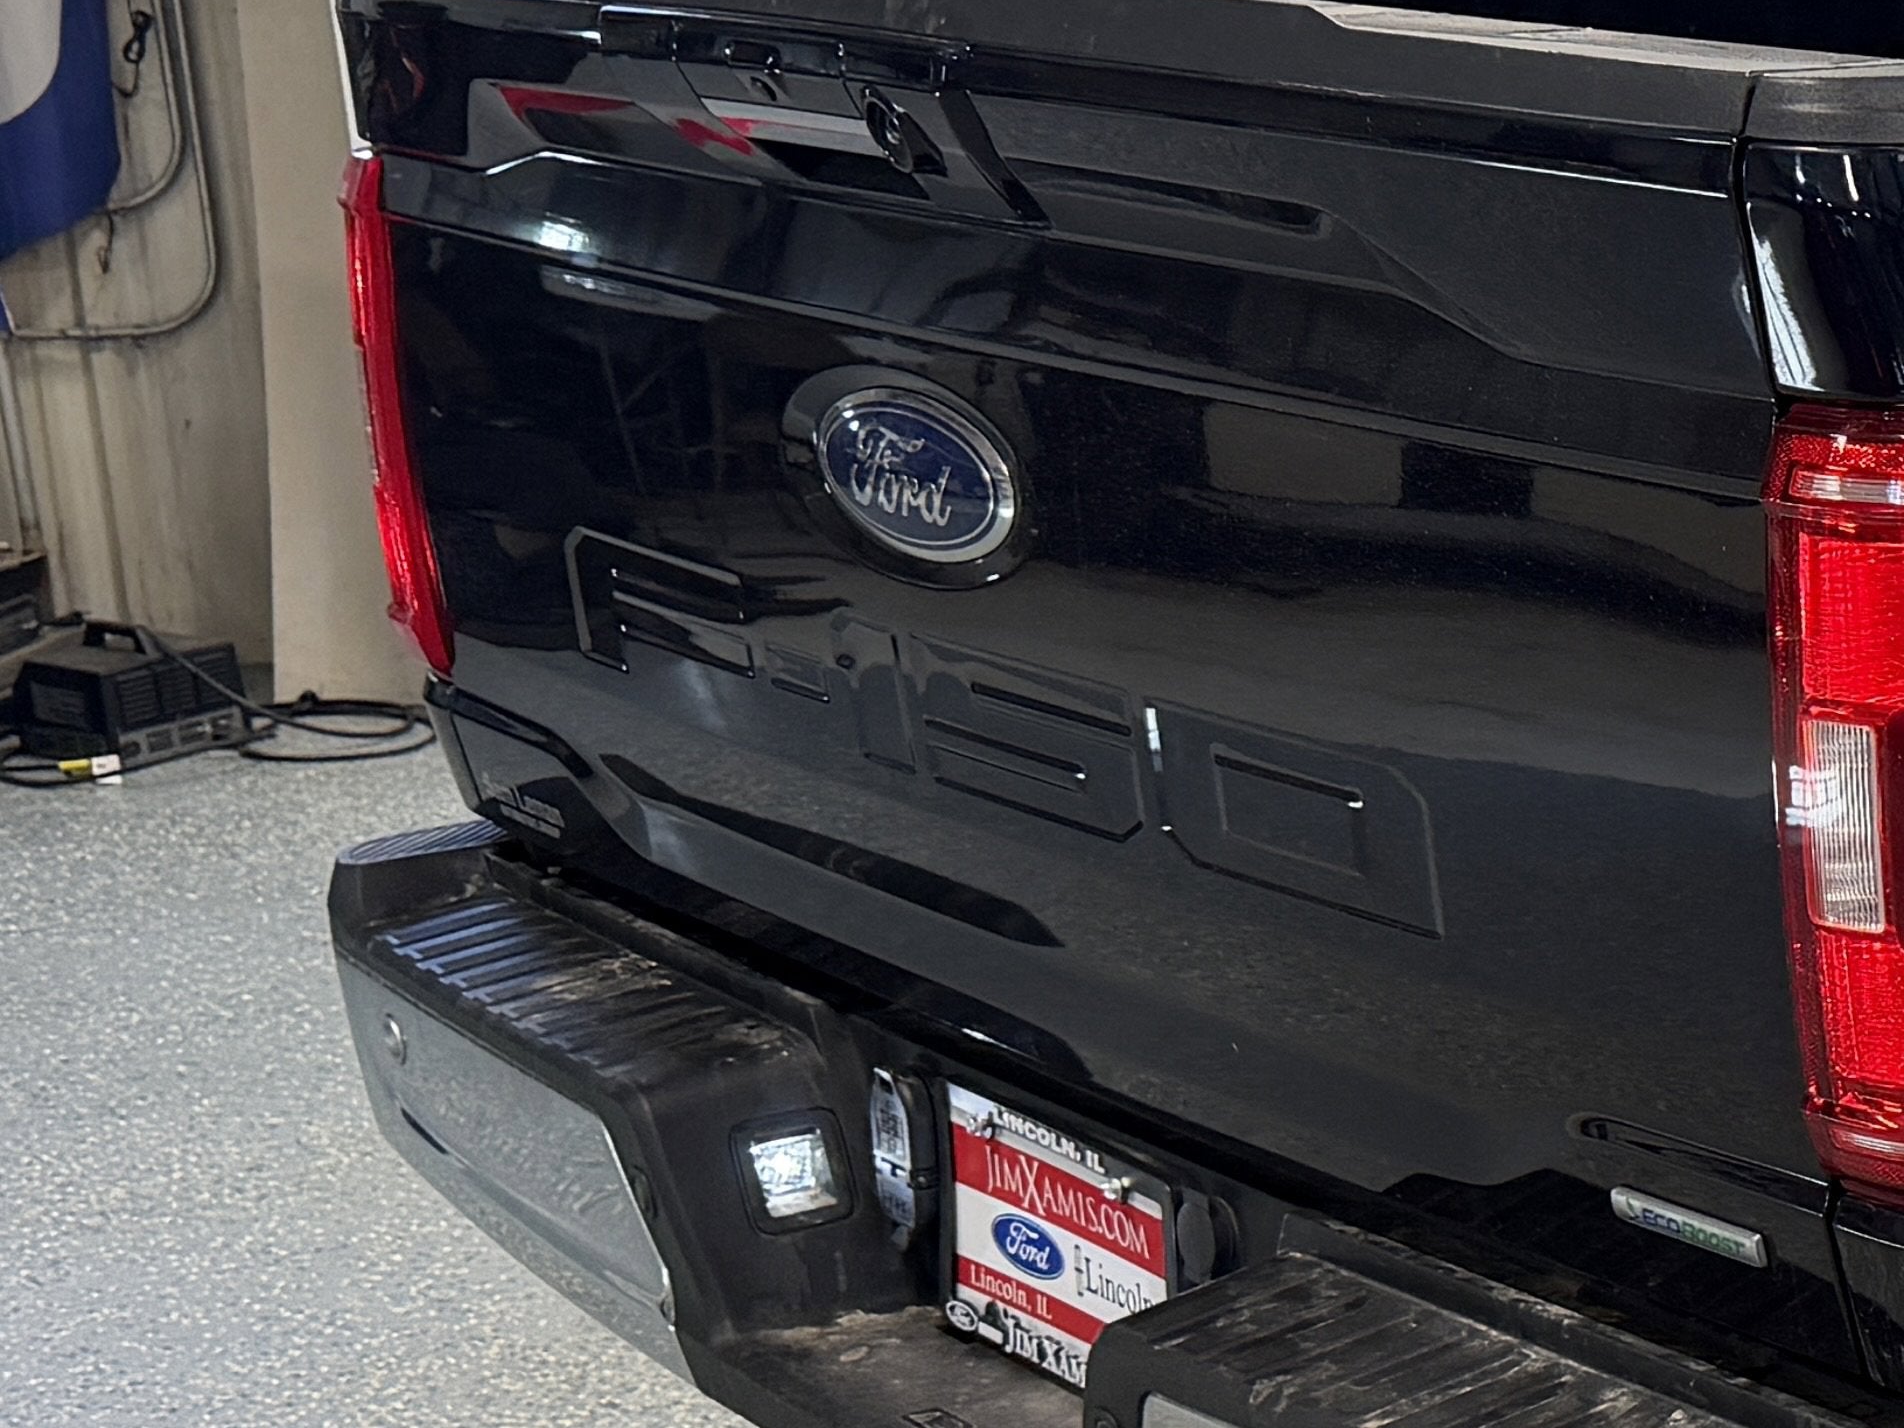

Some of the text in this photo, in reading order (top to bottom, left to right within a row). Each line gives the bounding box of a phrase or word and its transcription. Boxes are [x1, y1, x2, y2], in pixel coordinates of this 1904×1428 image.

[851, 425, 951, 526] Ford
[985, 1144, 1150, 1260] JIMXAMIS.COM
[1006, 1221, 1050, 1271] Ford
[969, 1264, 1053, 1320] Lincoln, IL
